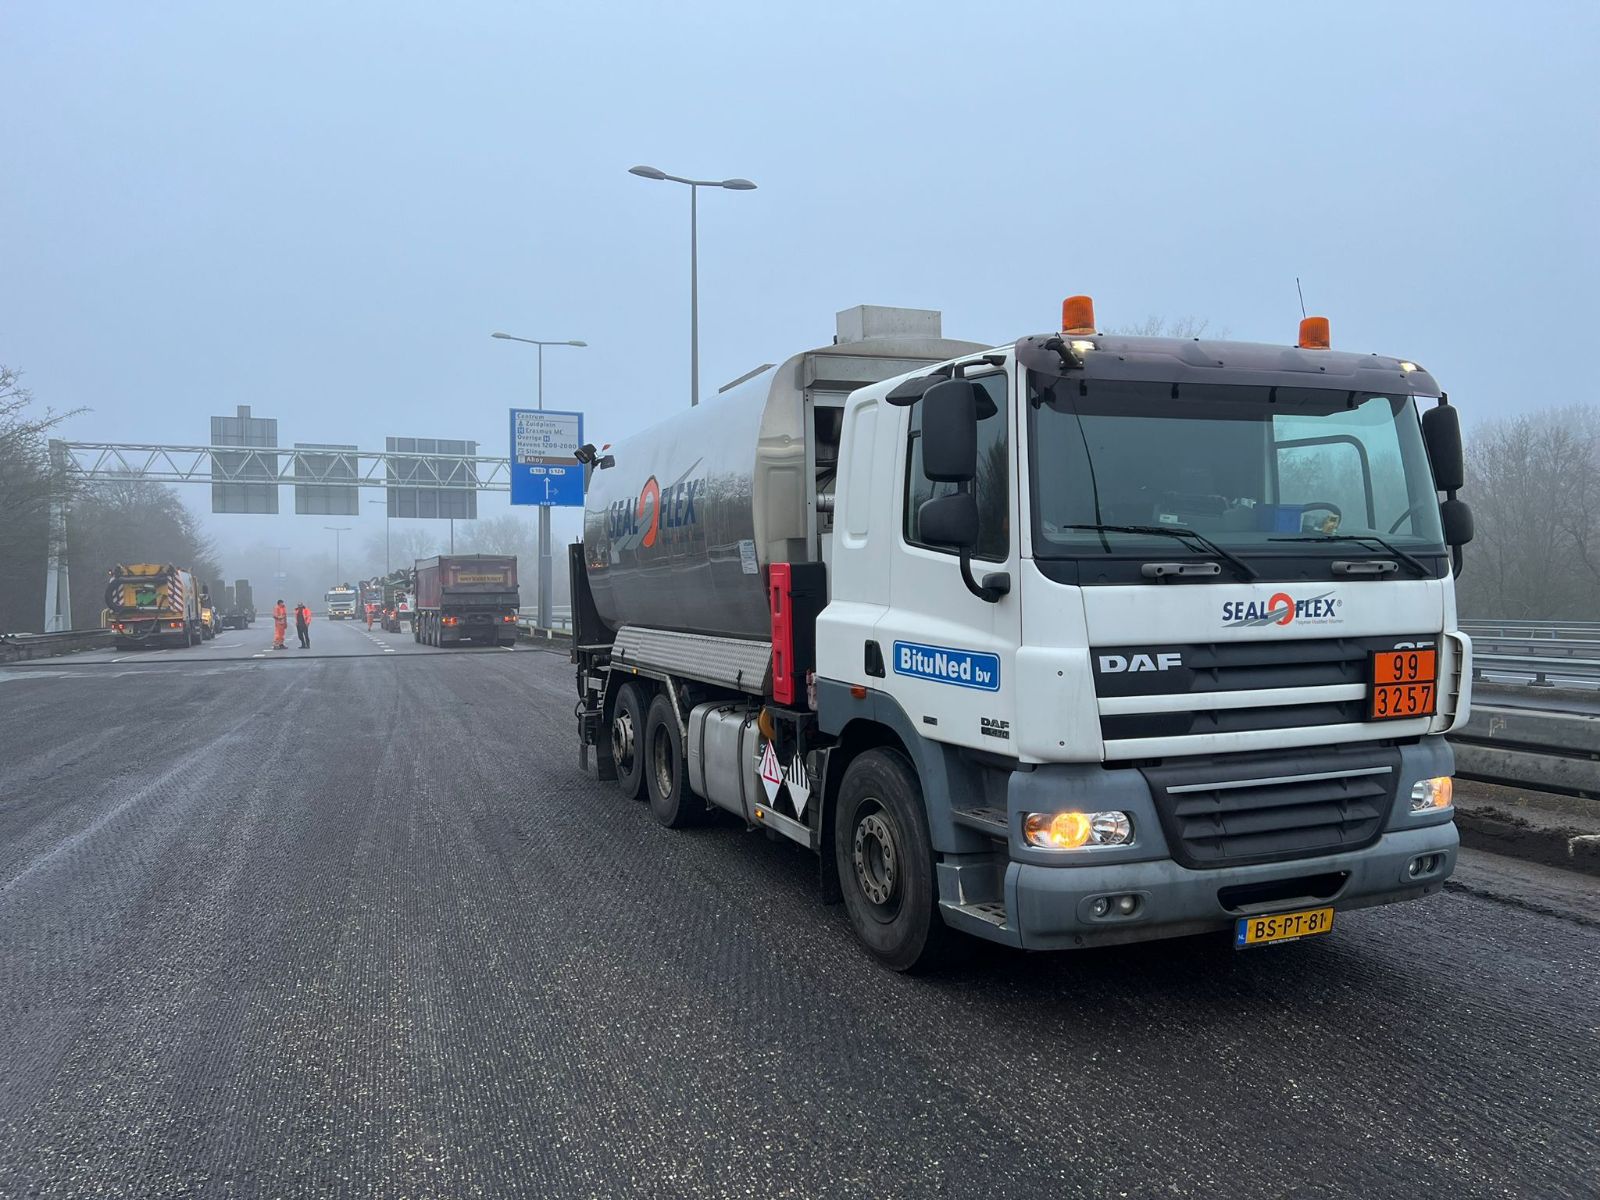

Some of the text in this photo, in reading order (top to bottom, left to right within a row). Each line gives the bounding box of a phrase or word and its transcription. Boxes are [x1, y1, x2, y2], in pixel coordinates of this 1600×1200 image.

[525, 420, 556, 428] Zuidplein
[526, 427, 552, 435] Erasmus
[900, 647, 992, 683] BituNed bv
[1098, 653, 1183, 673] DAF
[1393, 654, 1418, 680] 99
[1378, 685, 1431, 714] 3257
[980, 717, 1010, 729] DAF
[1255, 913, 1325, 938] BS-PT-81
